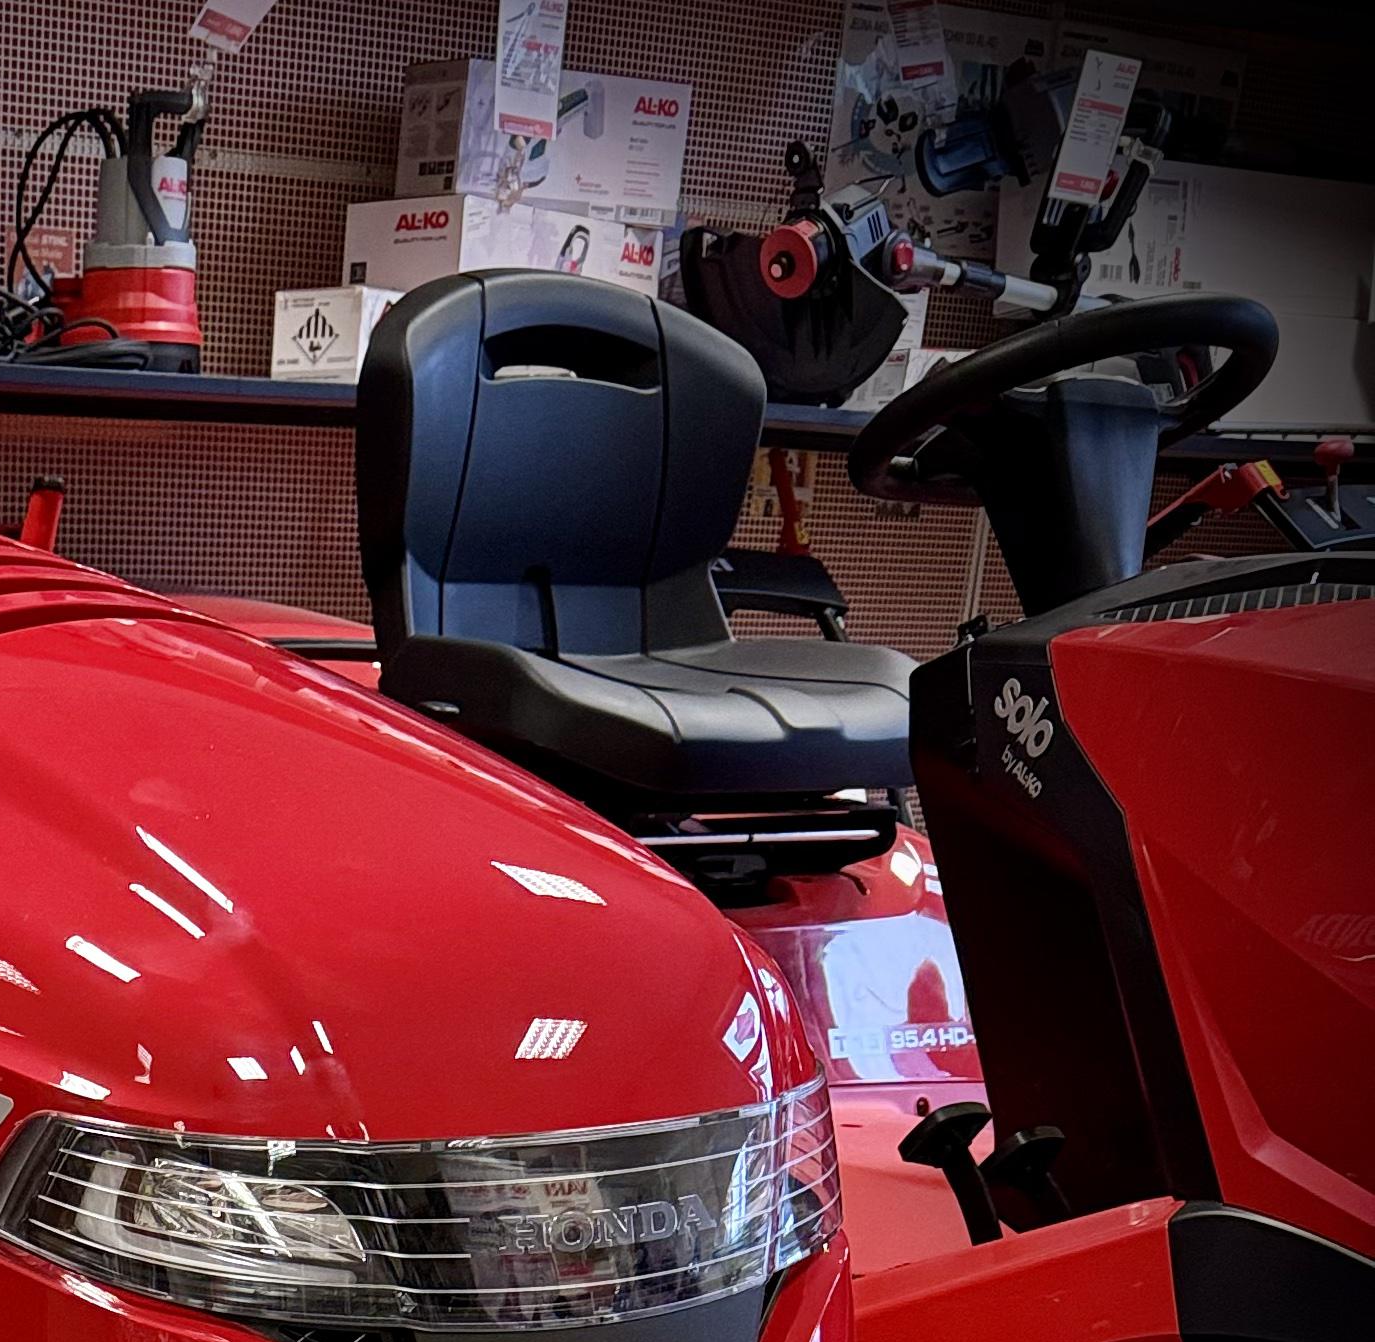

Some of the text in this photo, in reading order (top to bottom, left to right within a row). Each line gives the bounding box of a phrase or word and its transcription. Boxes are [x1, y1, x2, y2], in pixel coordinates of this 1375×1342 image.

[634, 96, 680, 118] AL-KO
[394, 210, 449, 232] AL-KO
[620, 241, 656, 267] AL-KO
[994, 677, 1054, 759] solo
[498, 1194, 719, 1255] HONDA
